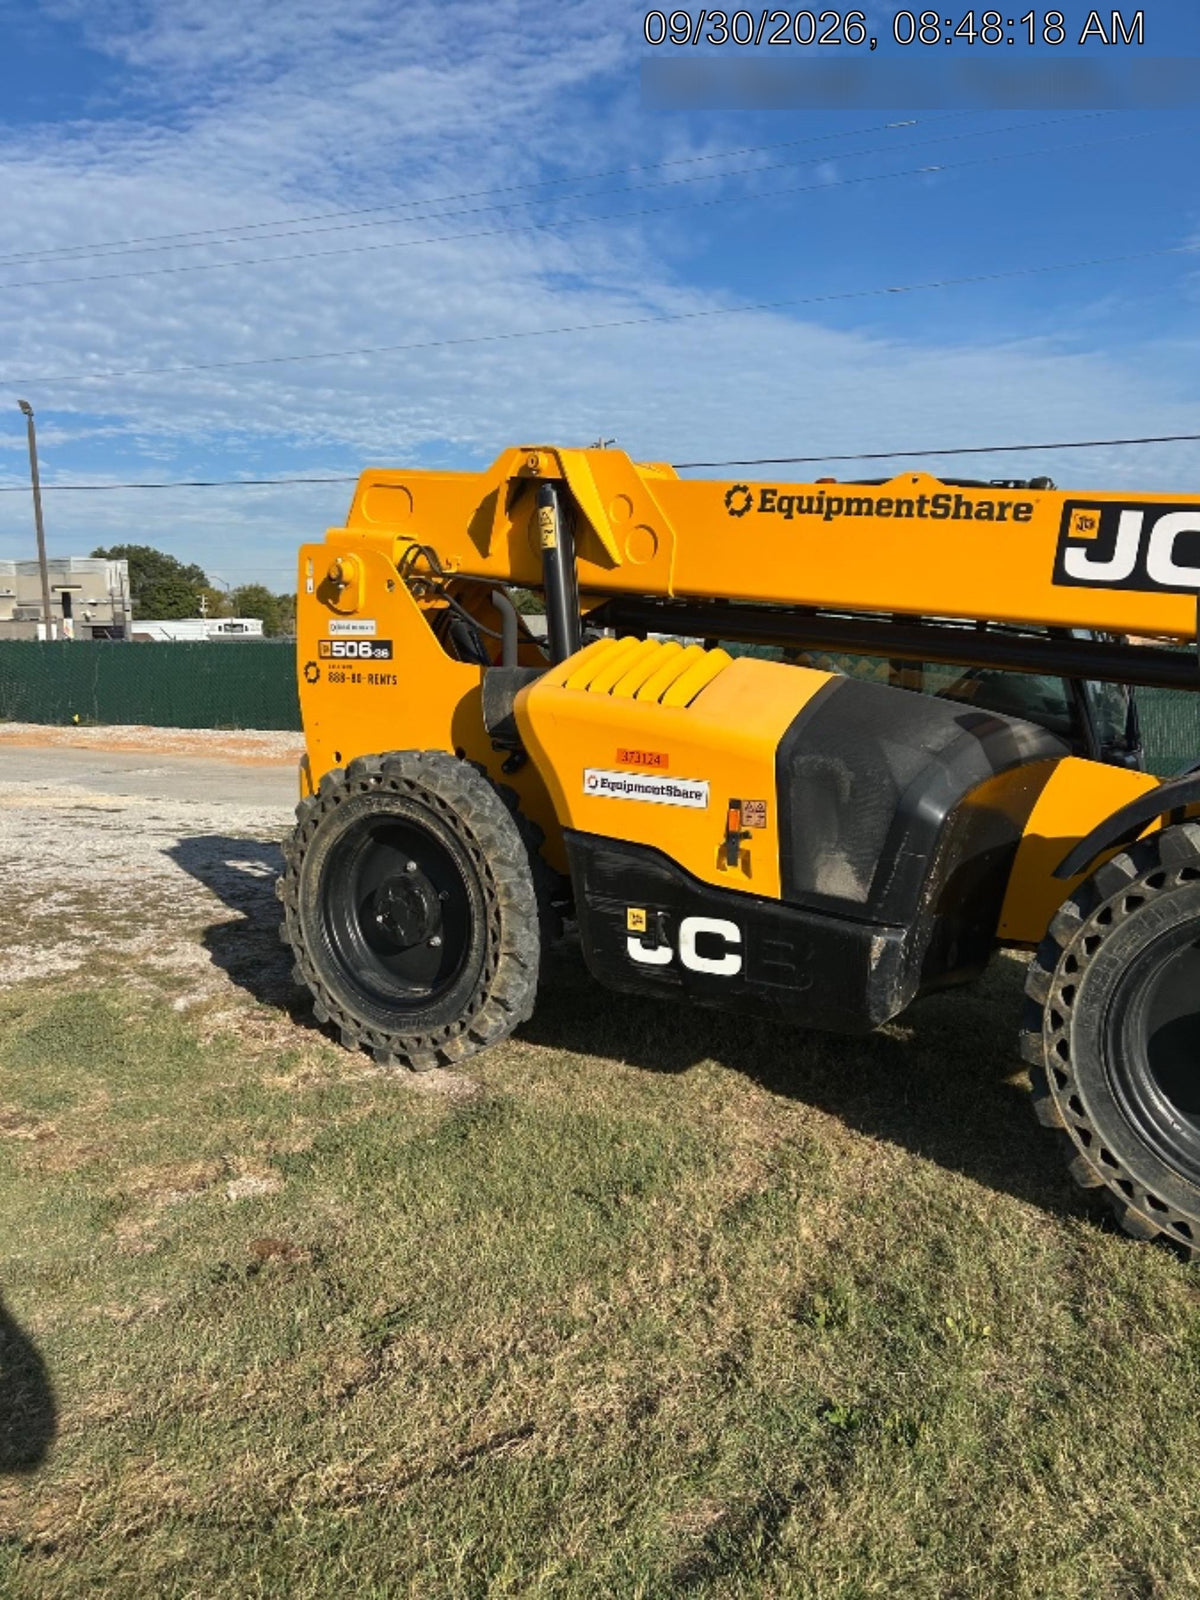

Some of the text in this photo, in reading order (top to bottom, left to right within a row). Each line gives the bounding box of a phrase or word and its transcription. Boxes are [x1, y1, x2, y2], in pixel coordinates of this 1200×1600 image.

[757, 488, 1034, 522] EquipmentShare
[621, 751, 661, 766] 373124
[600, 777, 703, 800] EquipmentShare
